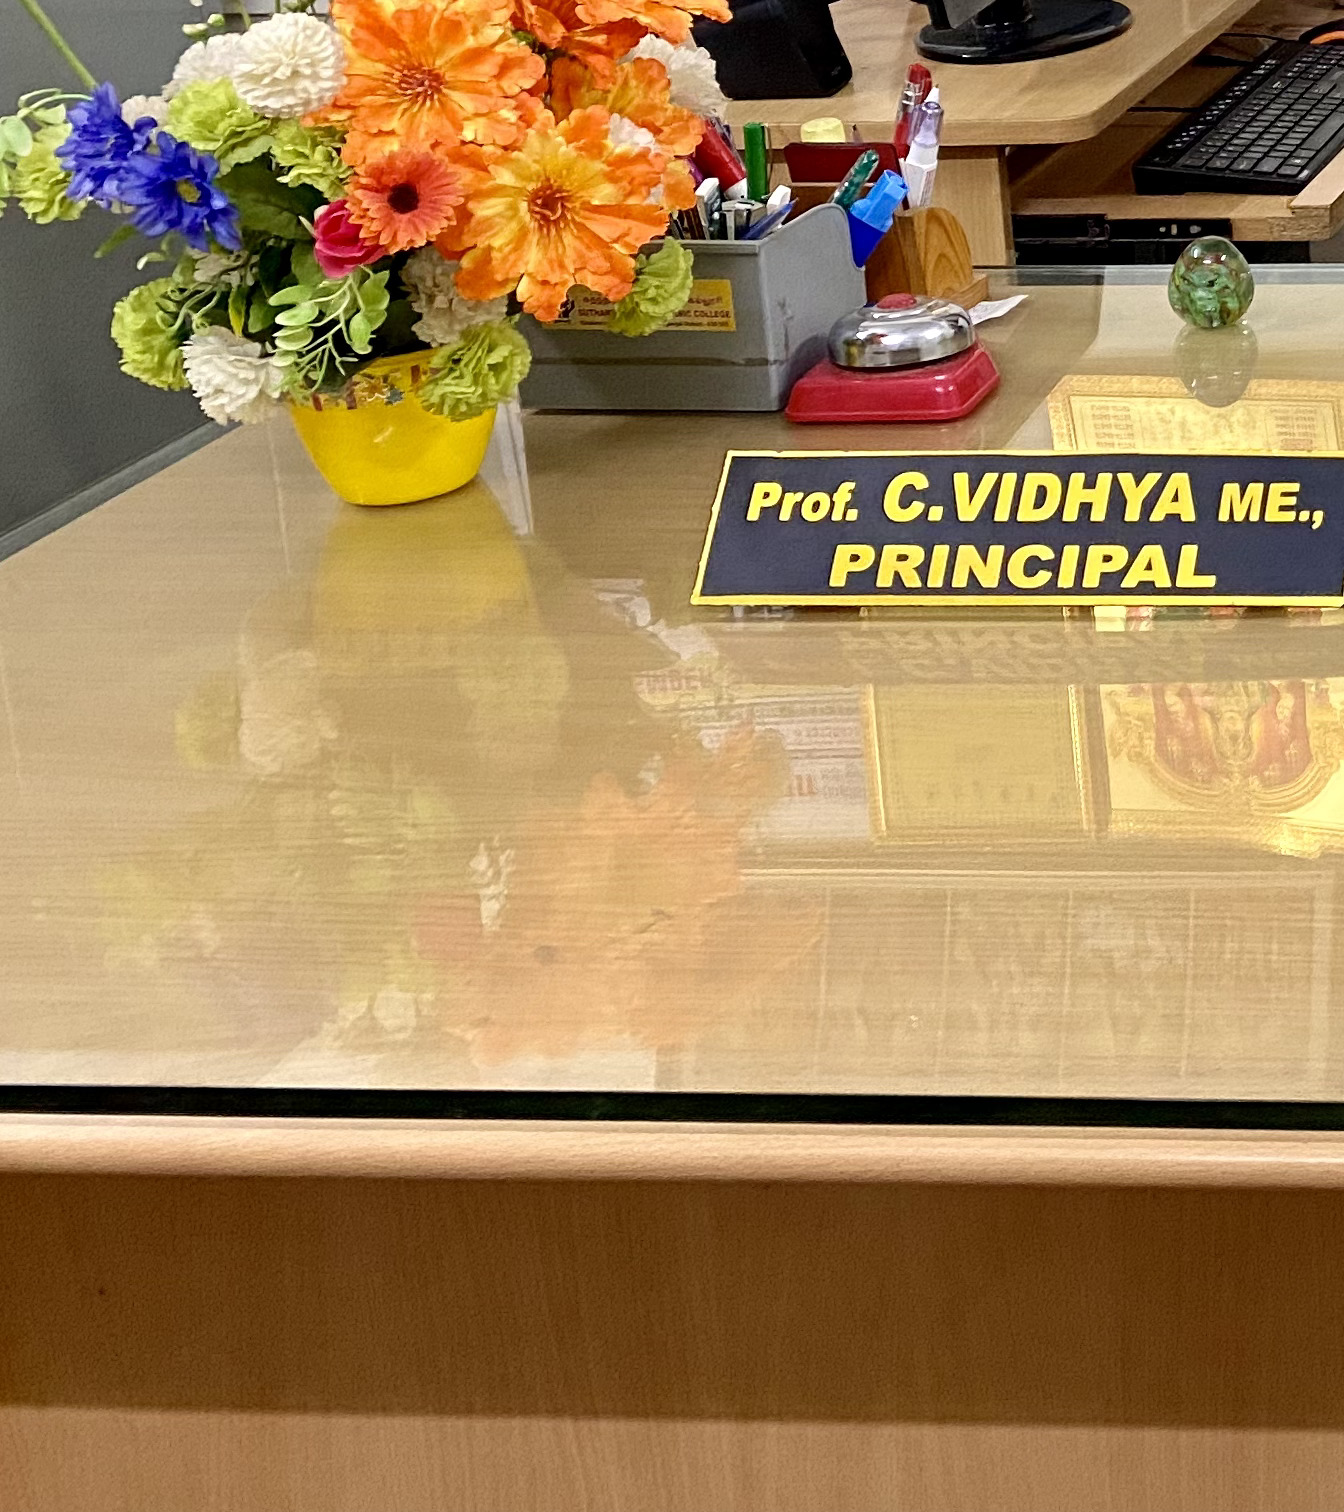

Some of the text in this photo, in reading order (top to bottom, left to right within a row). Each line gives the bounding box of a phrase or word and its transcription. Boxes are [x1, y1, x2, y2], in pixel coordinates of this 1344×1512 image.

[745, 471, 1326, 530] Prof. C.VIDHYA ME.,
[827, 542, 1218, 590] PRINCIPAL
